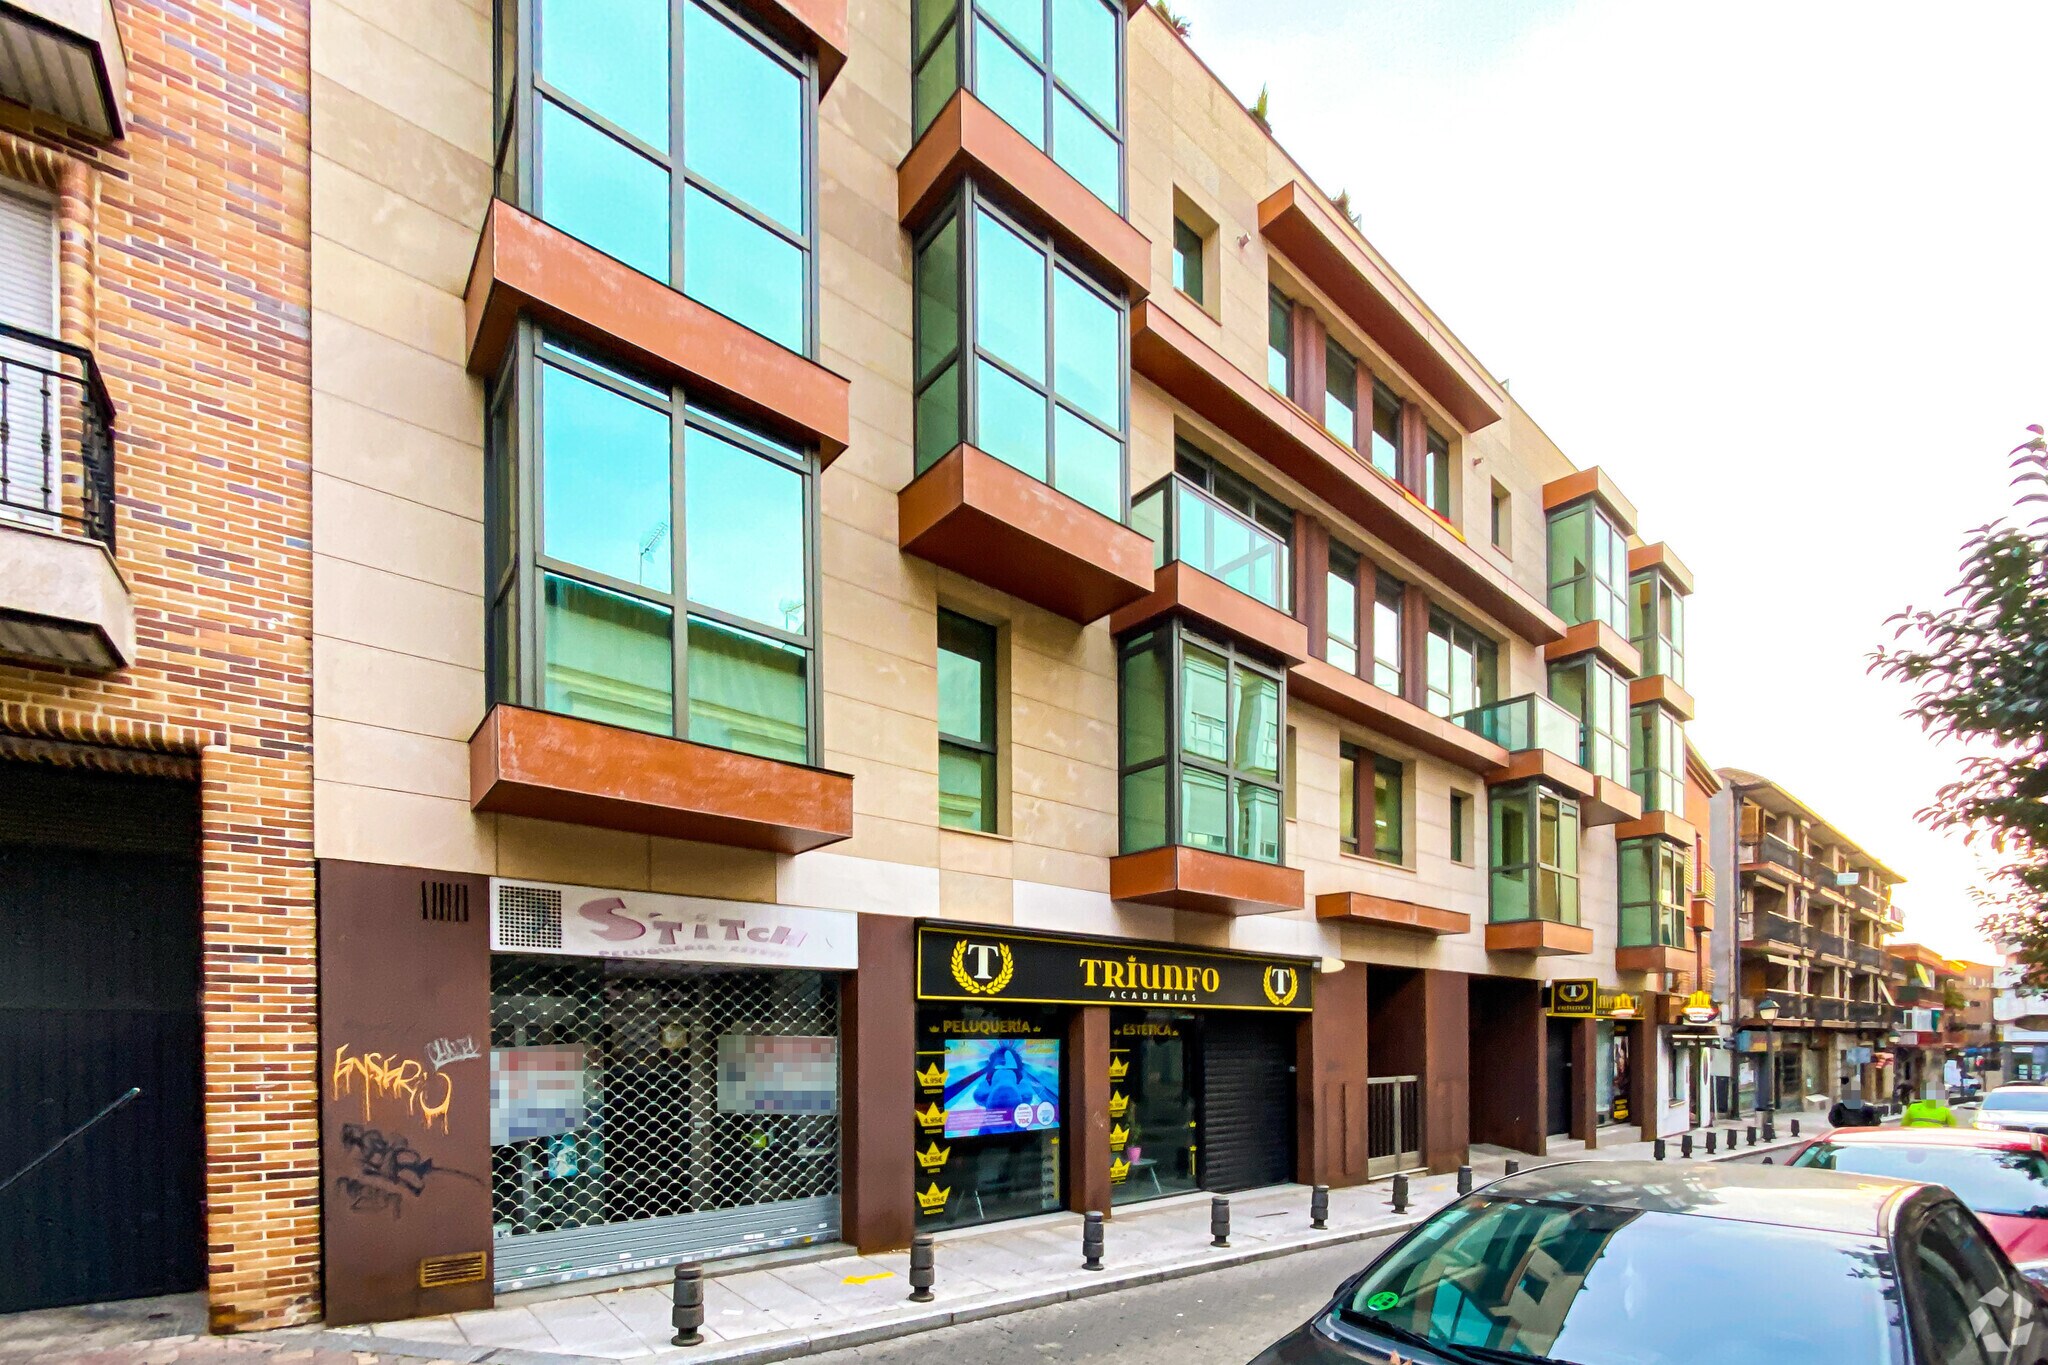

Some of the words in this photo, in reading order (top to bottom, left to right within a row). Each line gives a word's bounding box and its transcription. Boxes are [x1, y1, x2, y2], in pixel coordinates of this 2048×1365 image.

[967, 944, 999, 979] T
[1271, 968, 1290, 995] T
[1109, 990, 1197, 1002] ACADEMIAS
